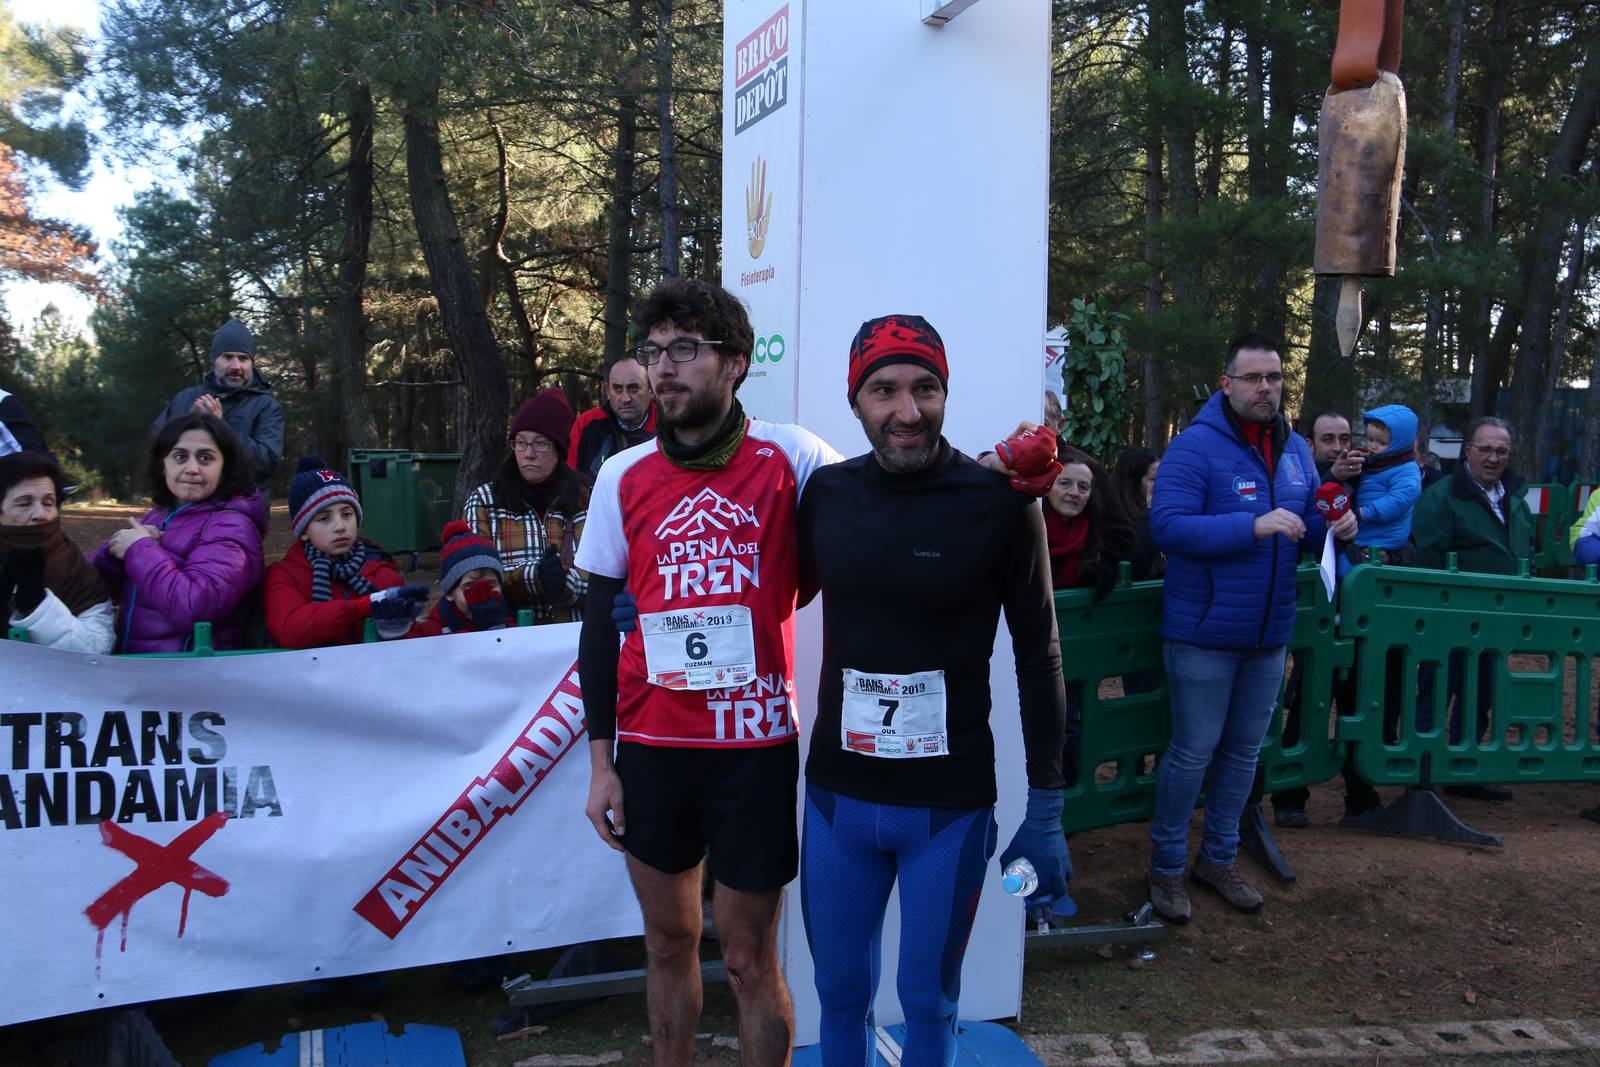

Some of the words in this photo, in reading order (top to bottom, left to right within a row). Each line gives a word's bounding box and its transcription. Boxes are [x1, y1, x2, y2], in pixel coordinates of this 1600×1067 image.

[737, 16, 787, 81] BRICO
[741, 265, 775, 287] Fisioterapia
[657, 553, 671, 565] LA
[738, 542, 760, 555] DEL
[658, 555, 760, 600] TREN
[707, 615, 732, 626] 2019
[685, 632, 708, 660] 6
[902, 683, 925, 695] 2019
[879, 699, 899, 726] 7
[0, 711, 227, 770] TRANS
